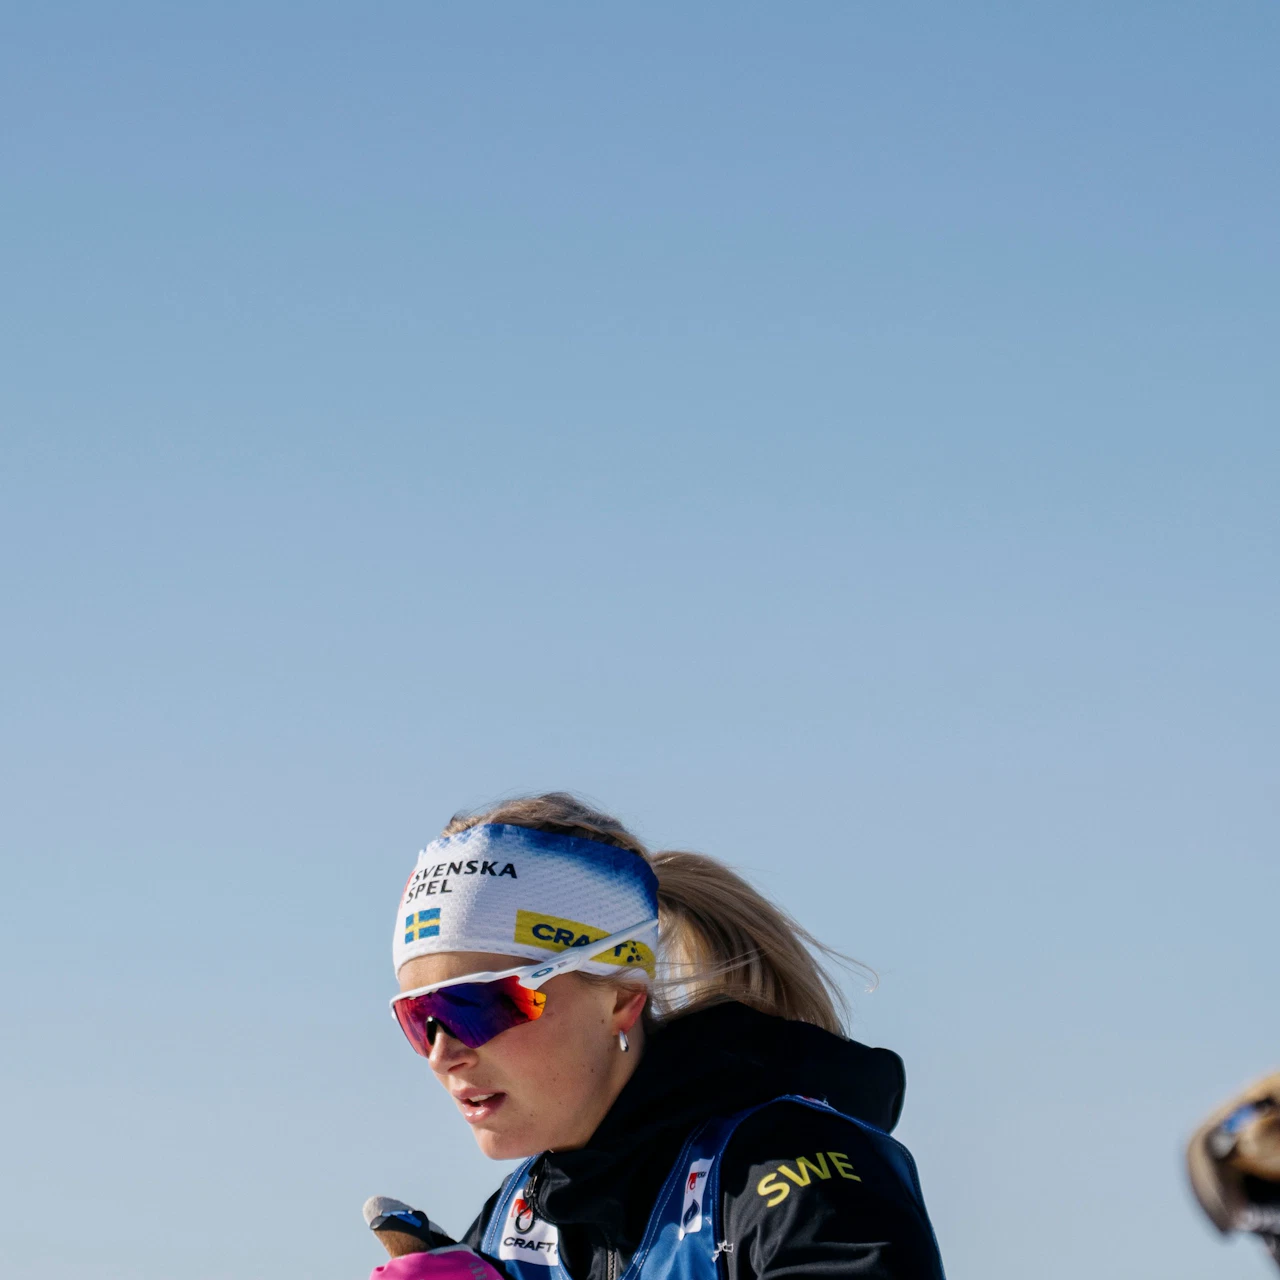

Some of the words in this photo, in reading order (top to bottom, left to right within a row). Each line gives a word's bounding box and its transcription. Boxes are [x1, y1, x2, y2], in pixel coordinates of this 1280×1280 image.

[412, 860, 518, 886] SVENSKA
[406, 879, 453, 904] SPEL
[532, 923, 628, 957] CRAT
[757, 1151, 862, 1207] SWE
[503, 1236, 555, 1253] CRAFT
